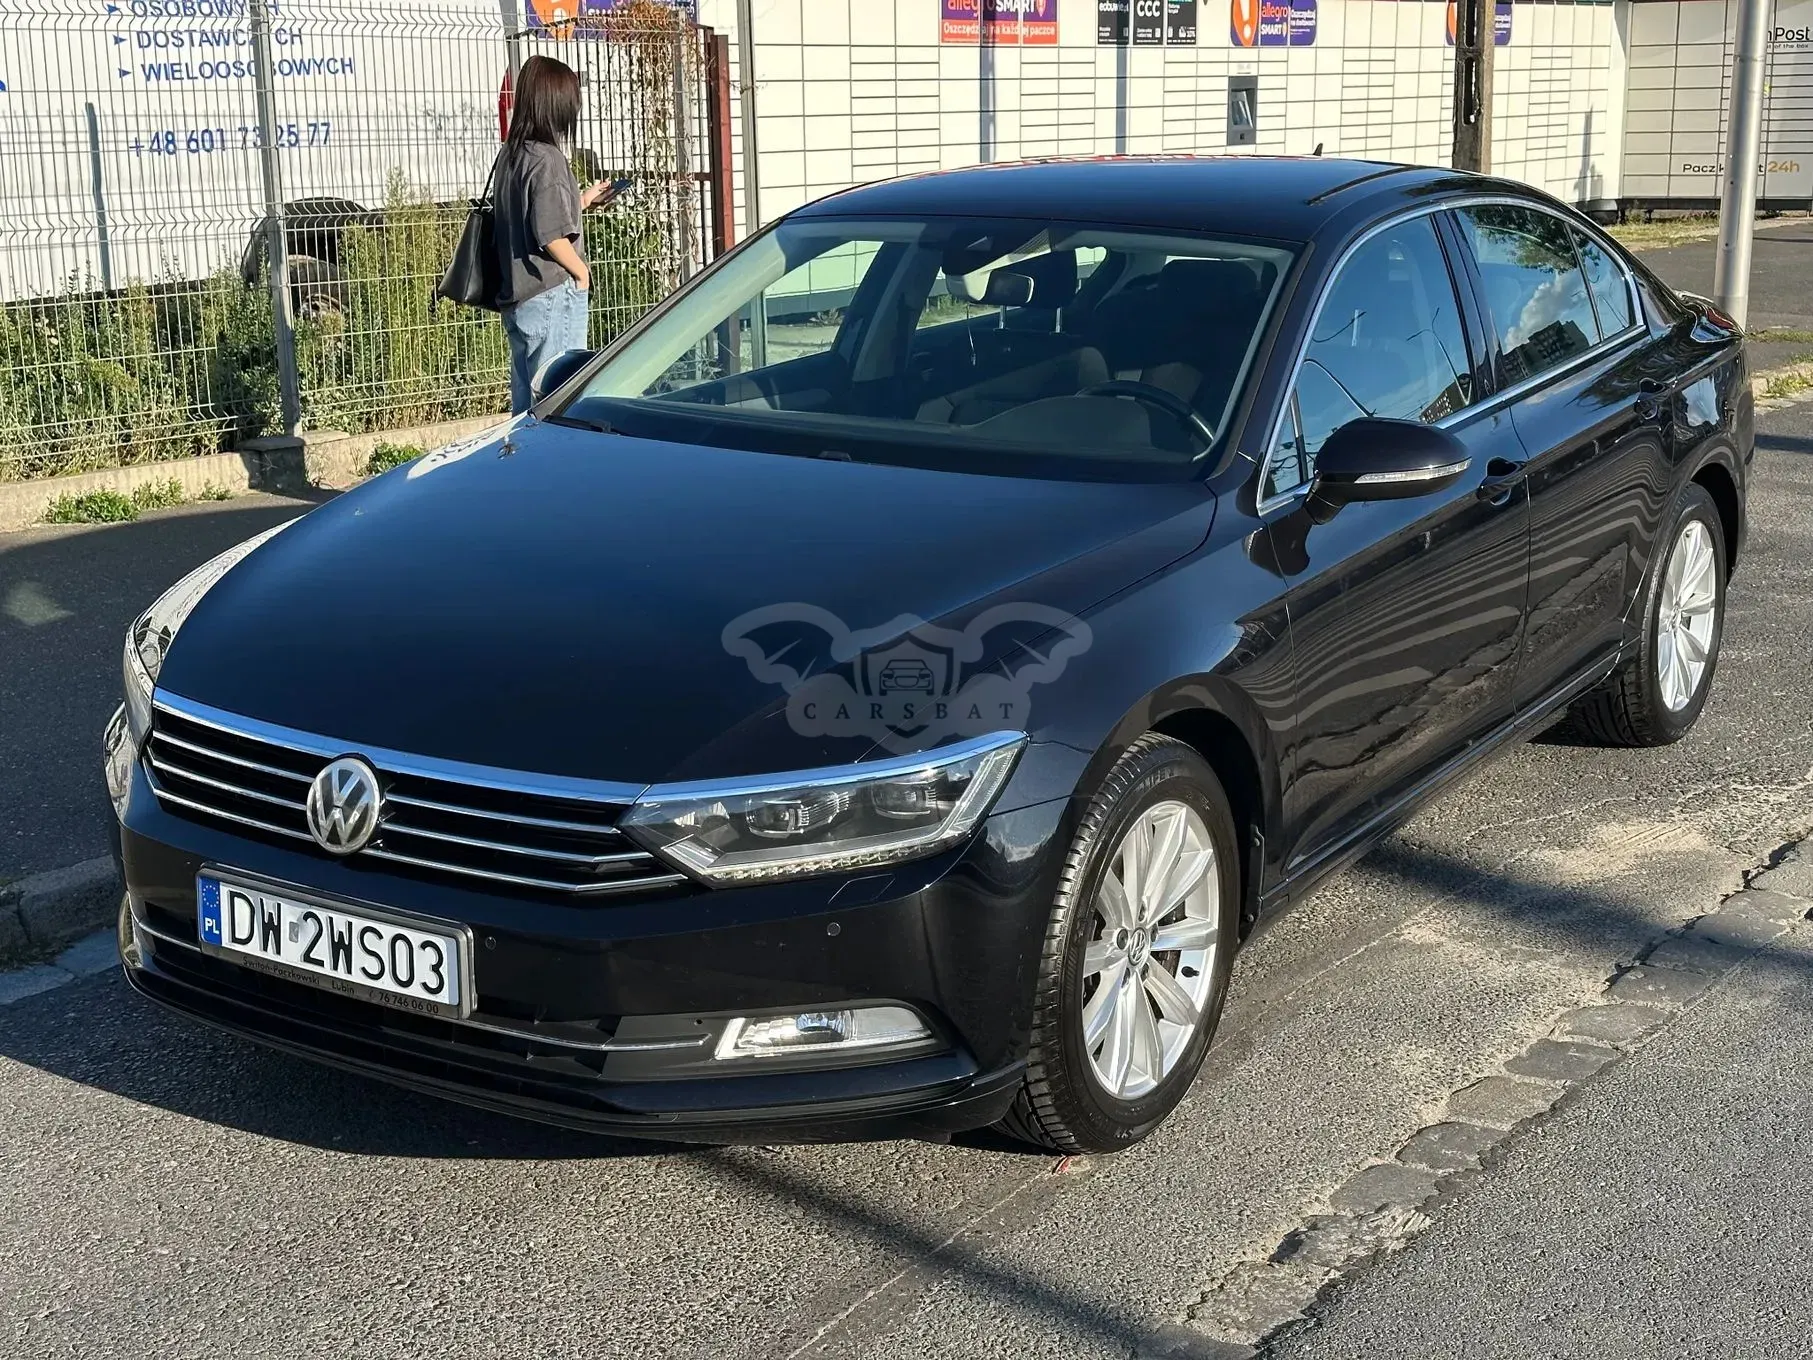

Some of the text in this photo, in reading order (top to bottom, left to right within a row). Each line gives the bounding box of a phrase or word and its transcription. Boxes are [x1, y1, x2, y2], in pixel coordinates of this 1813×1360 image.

[131, 0, 280, 17] OSOBOWYH
[1136, 0, 1161, 18] CCC
[1261, 2, 1288, 22] allegro
[135, 27, 304, 49] DOSTAWCCH
[1261, 23, 1283, 35] SMART
[187, 127, 227, 154] 601
[307, 122, 331, 145] 77
[1682, 159, 1800, 174] Paczkt 24h
[204, 916, 219, 935] PL
[228, 888, 446, 996] DW 2WS03
[331, 979, 355, 995] Lubin
[427, 1002, 440, 1014] 00
